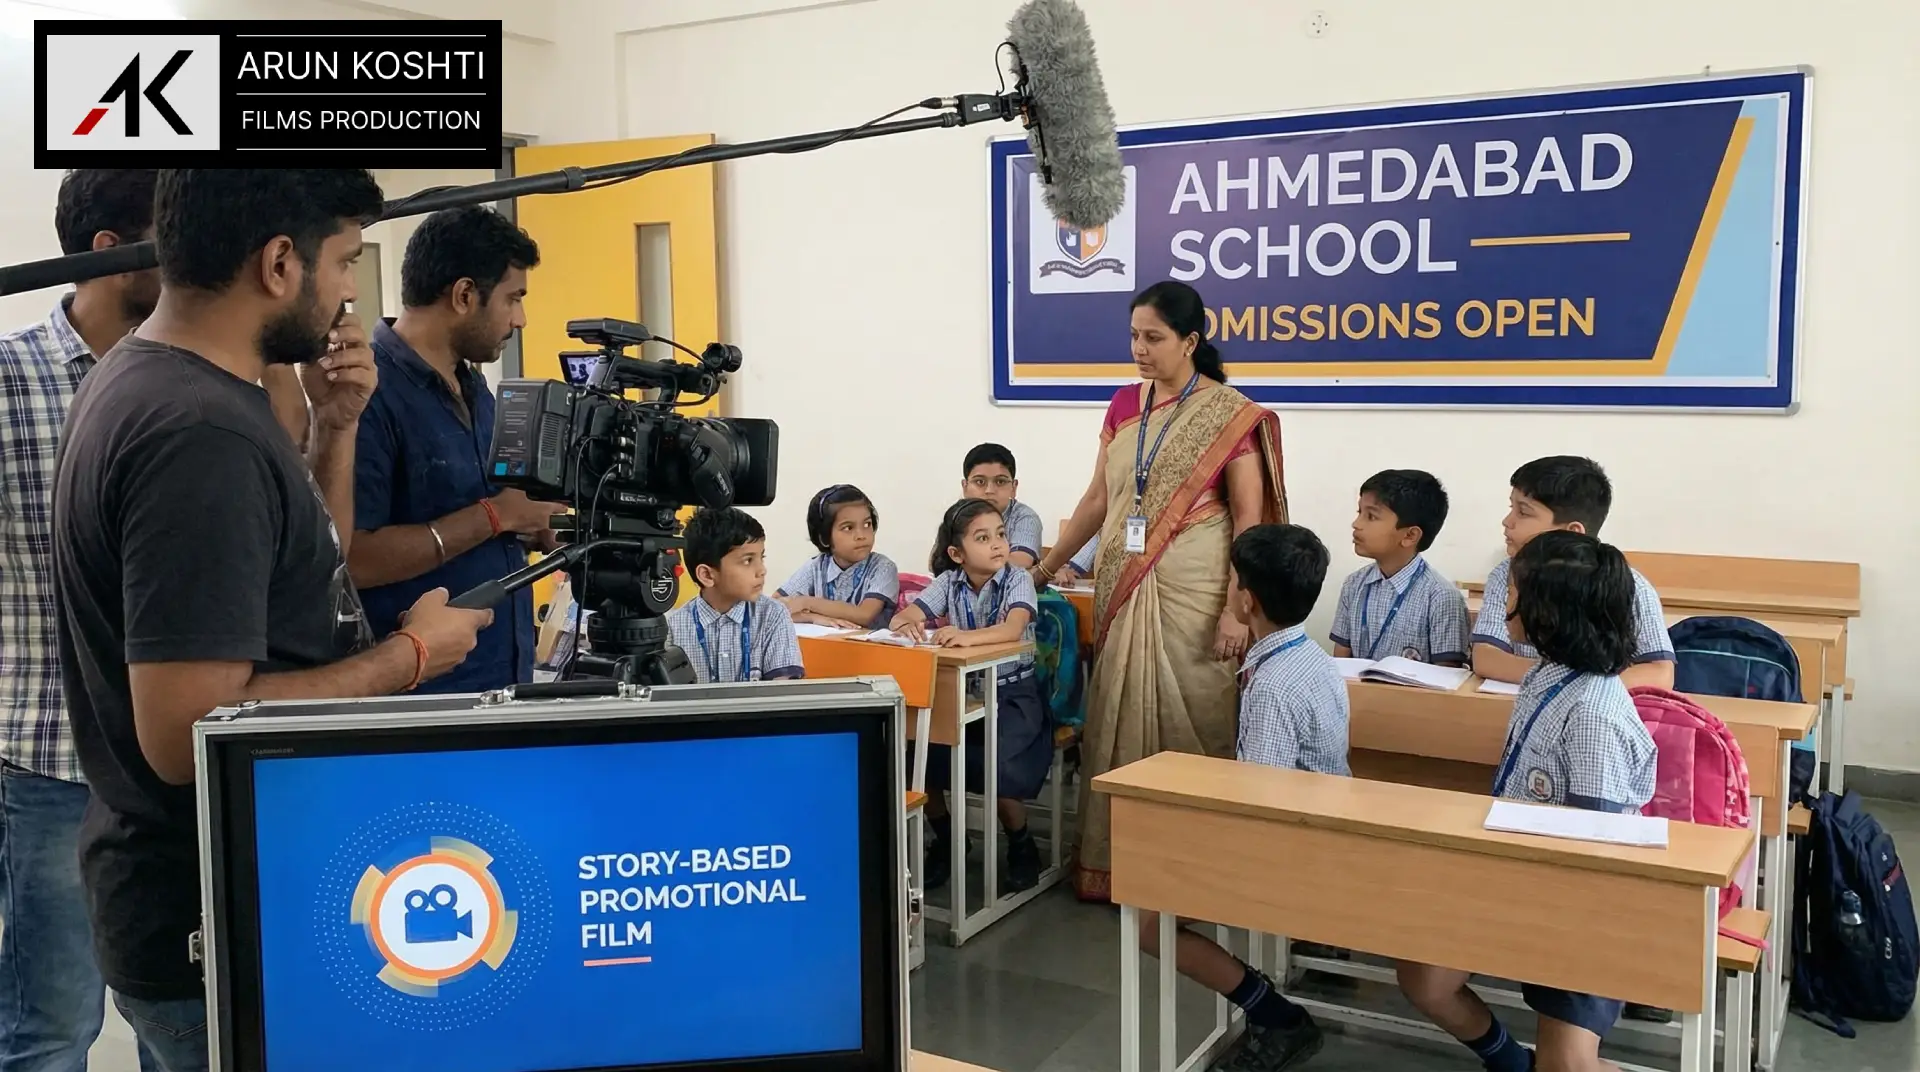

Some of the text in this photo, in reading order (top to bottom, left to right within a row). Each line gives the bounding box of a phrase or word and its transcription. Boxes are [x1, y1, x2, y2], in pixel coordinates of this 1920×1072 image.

[1168, 133, 1633, 215] AHMEDABAD
[1168, 218, 1458, 282] SCHOOL
[1203, 297, 1595, 342] MISSIONS OPEN
[578, 844, 791, 881] STORY-BASED
[580, 878, 807, 916] PROMOTIONAL
[581, 921, 653, 949] FILM
